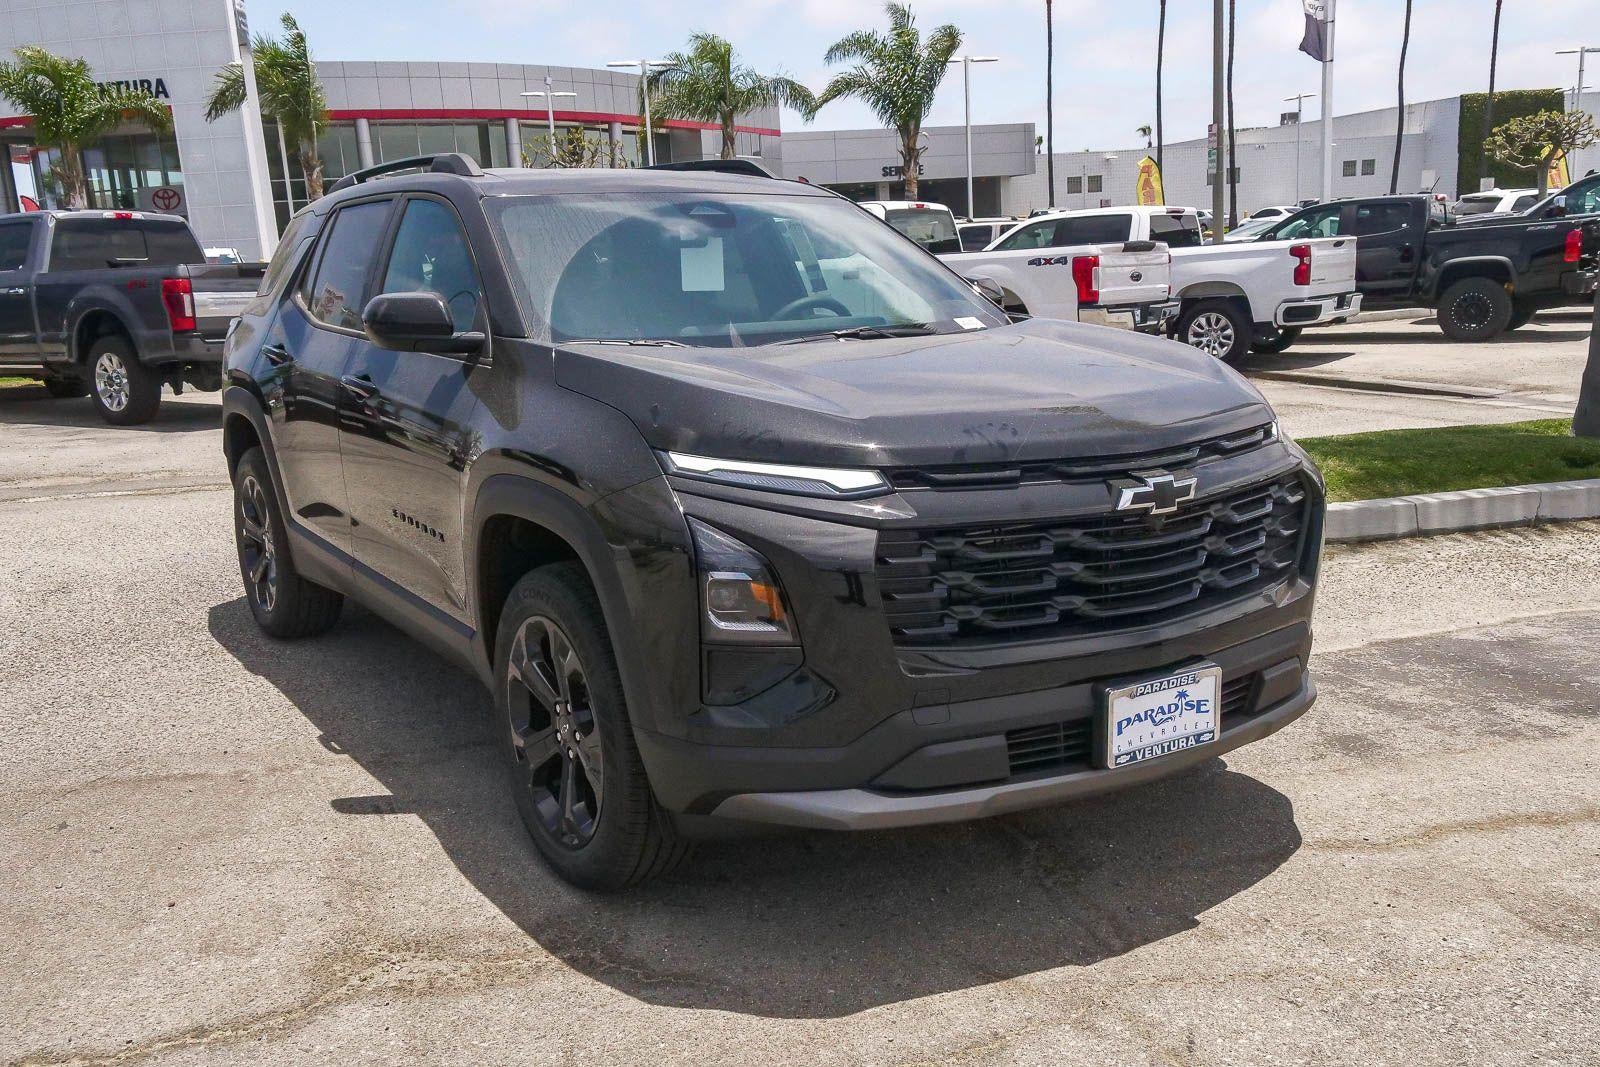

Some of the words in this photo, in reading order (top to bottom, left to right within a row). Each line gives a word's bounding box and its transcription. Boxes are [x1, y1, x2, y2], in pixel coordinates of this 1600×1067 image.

[1135, 673, 1197, 698] PARADISE
[1116, 689, 1210, 737] PARADISE
[1117, 721, 1210, 753] CHEVROLET
[1135, 736, 1197, 760] VENTURA
